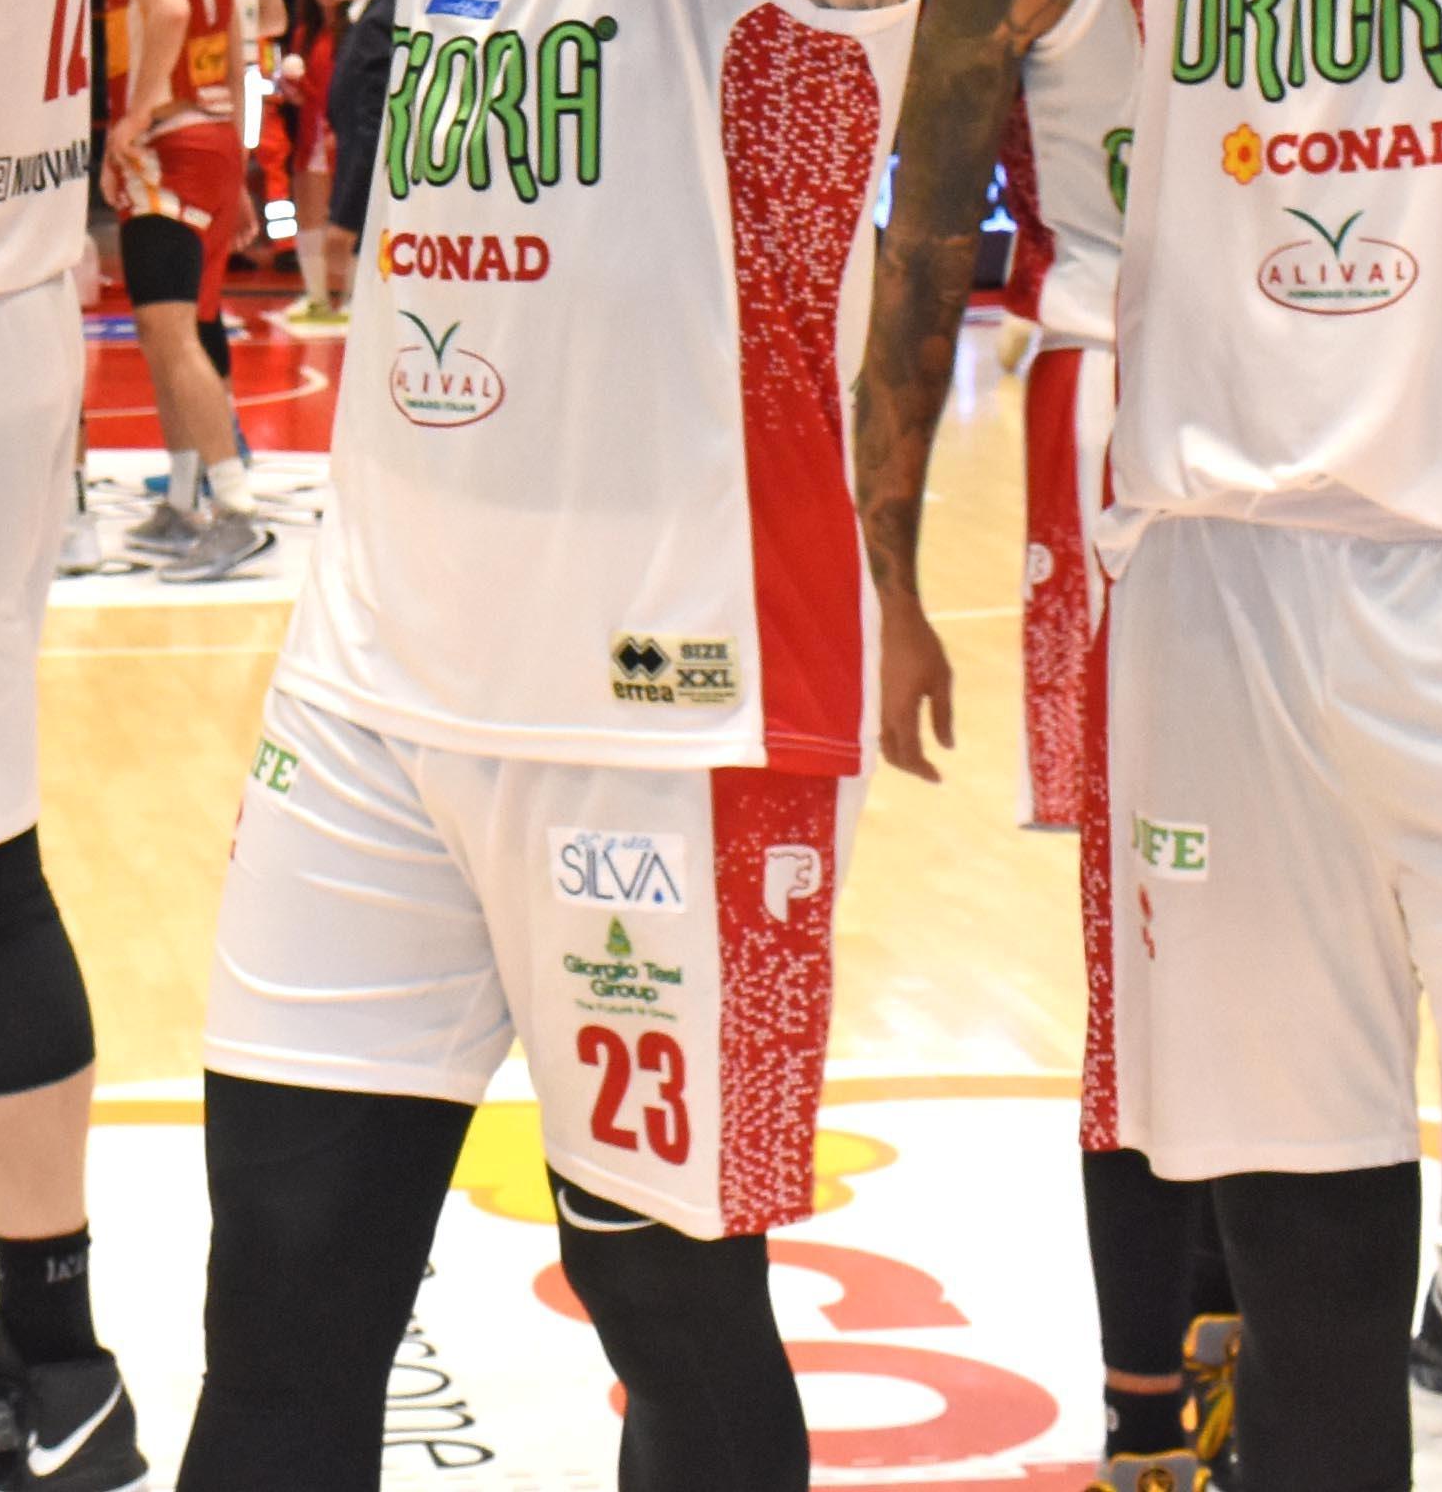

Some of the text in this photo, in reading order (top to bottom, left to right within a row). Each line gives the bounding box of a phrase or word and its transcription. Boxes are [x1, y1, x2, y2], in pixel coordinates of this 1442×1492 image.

[390, 232, 550, 282] CONAD
[1268, 260, 1406, 286] ALIVAL
[677, 668, 735, 688] XXL
[613, 680, 675, 703] errea
[558, 843, 683, 904] SILVA
[590, 978, 659, 1004] Group
[575, 1025, 692, 1167] 23
